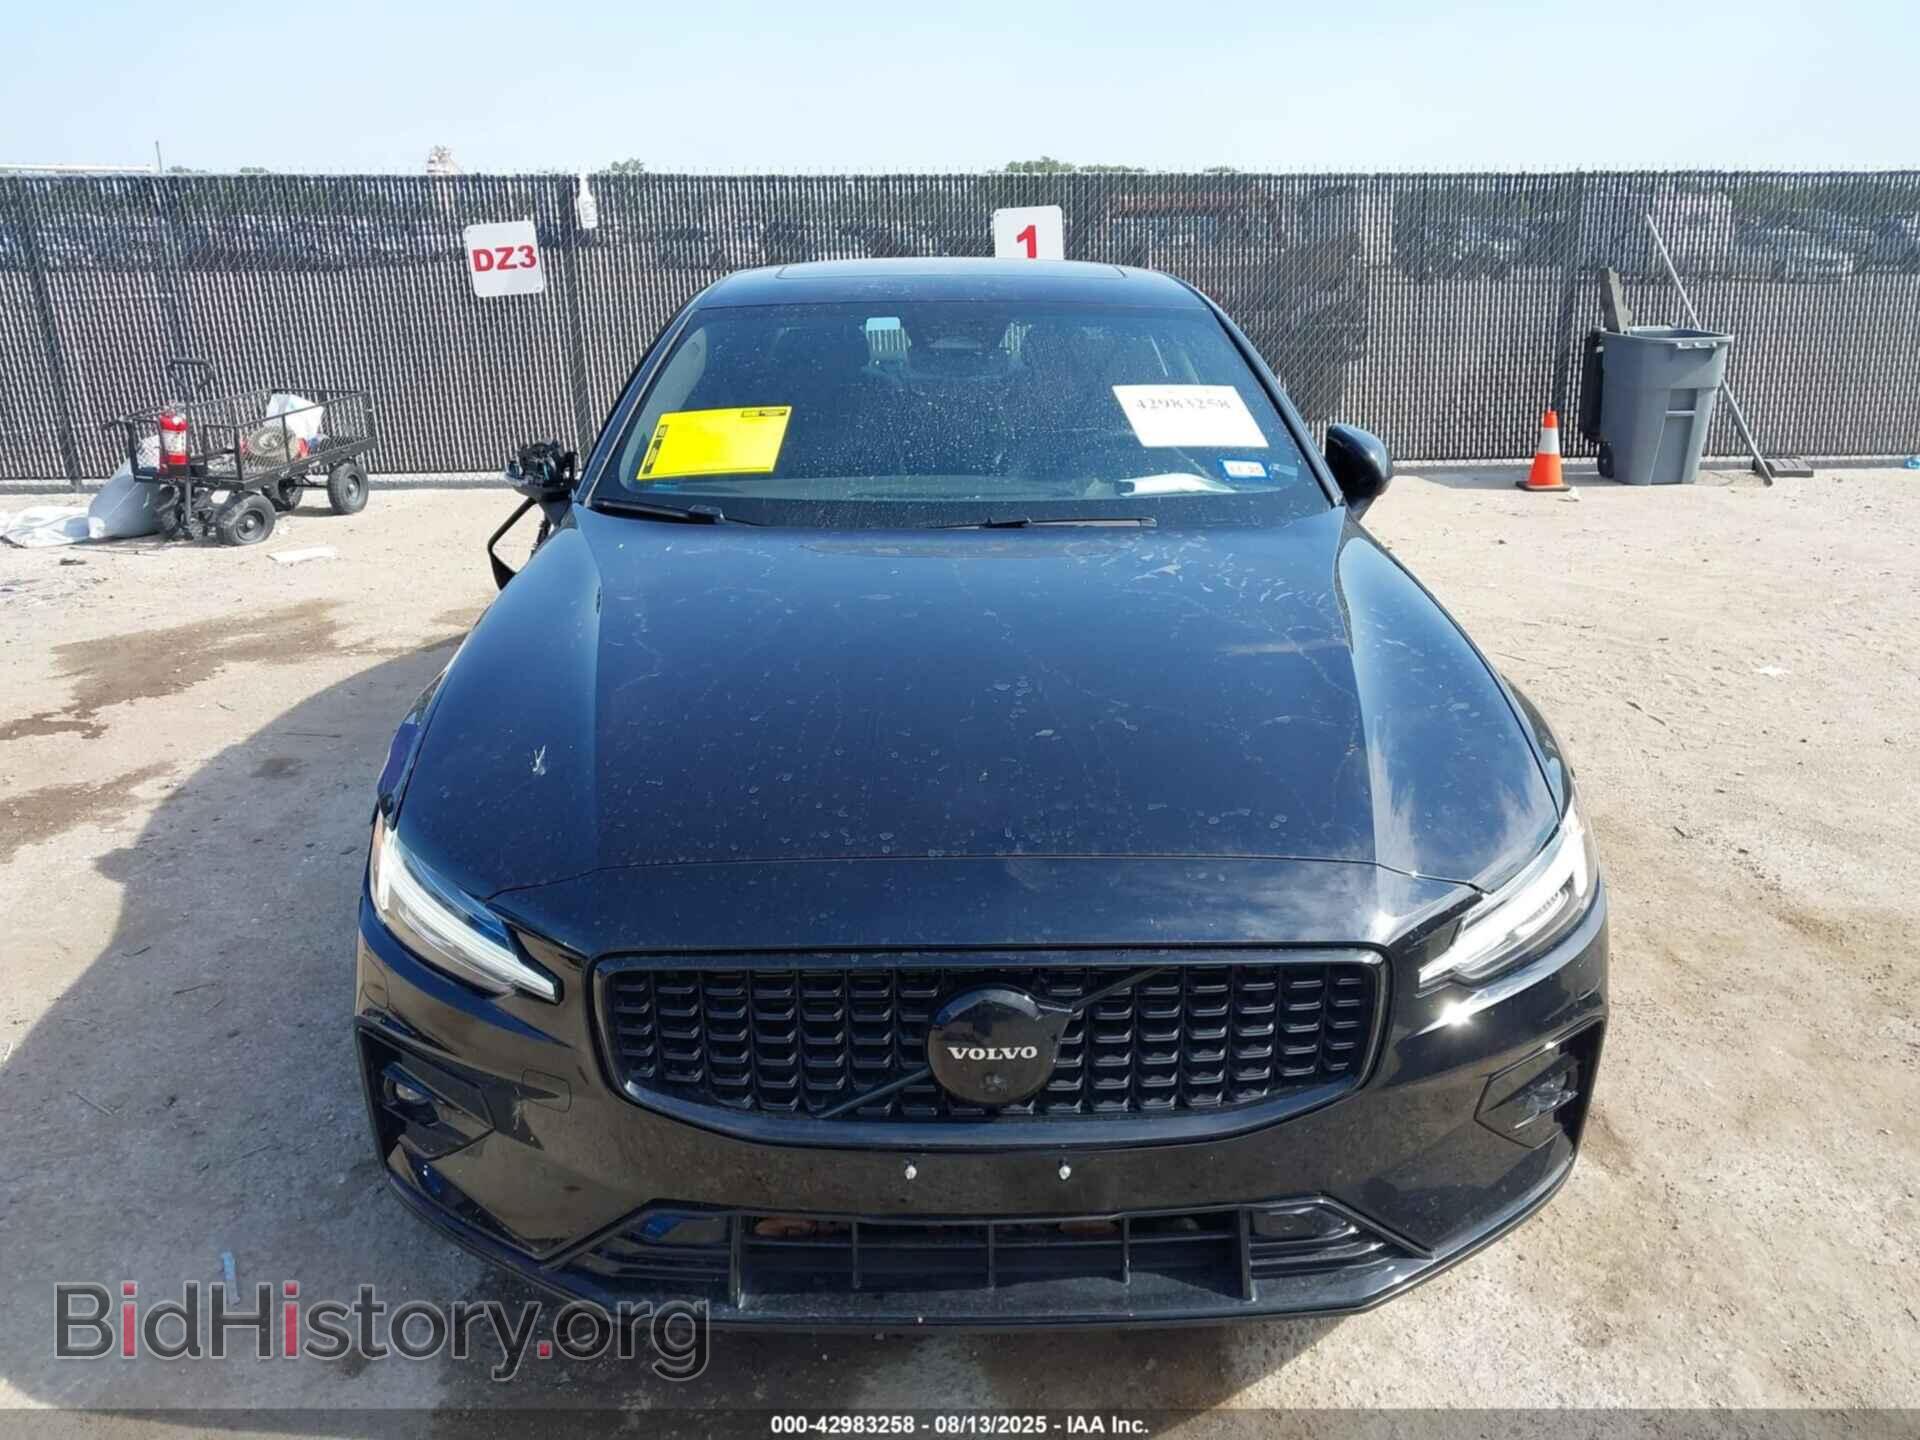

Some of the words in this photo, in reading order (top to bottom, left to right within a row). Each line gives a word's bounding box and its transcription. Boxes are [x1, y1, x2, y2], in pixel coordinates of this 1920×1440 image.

[1016, 224, 1037, 259] 1
[472, 244, 537, 272] DZ3
[947, 1045, 1038, 1061] VOLVO
